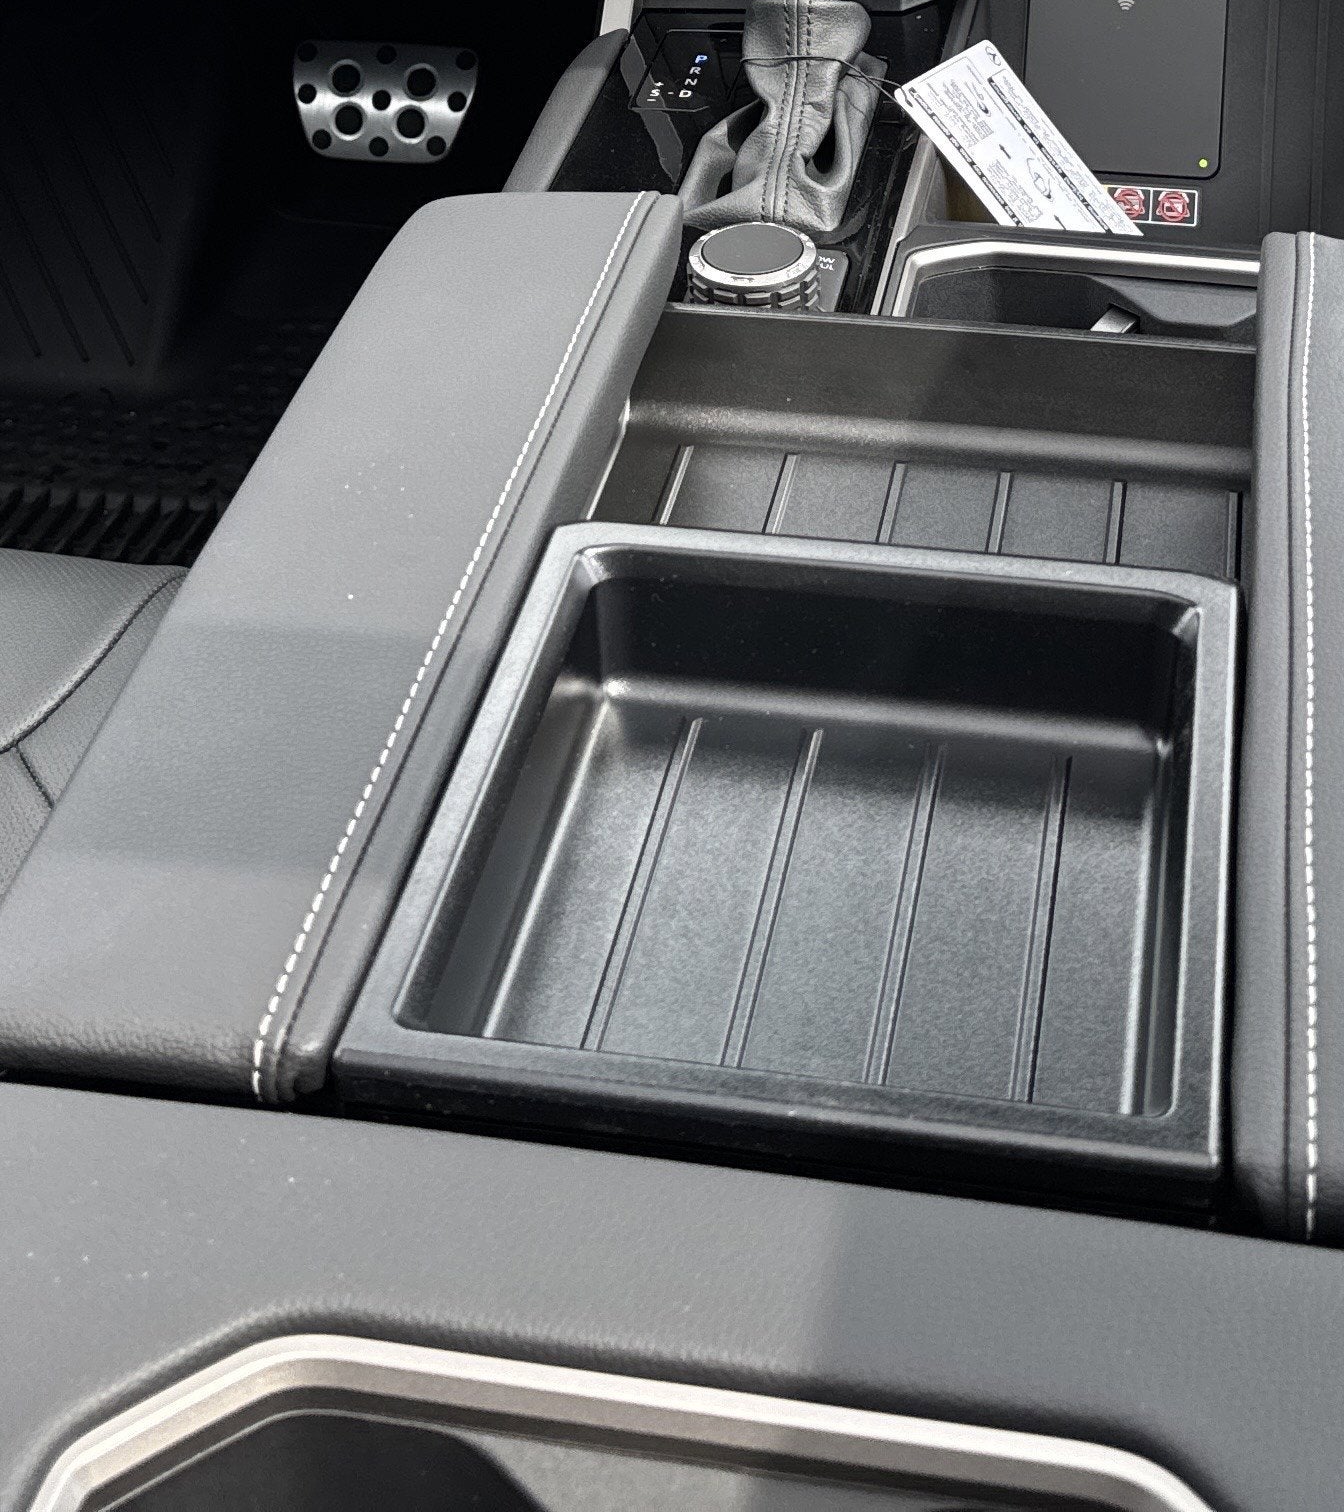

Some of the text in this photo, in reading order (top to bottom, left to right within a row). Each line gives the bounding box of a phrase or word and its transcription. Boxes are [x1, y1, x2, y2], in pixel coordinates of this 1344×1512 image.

[694, 54, 708, 64] P
[689, 66, 702, 75] R
[678, 89, 692, 98] D
